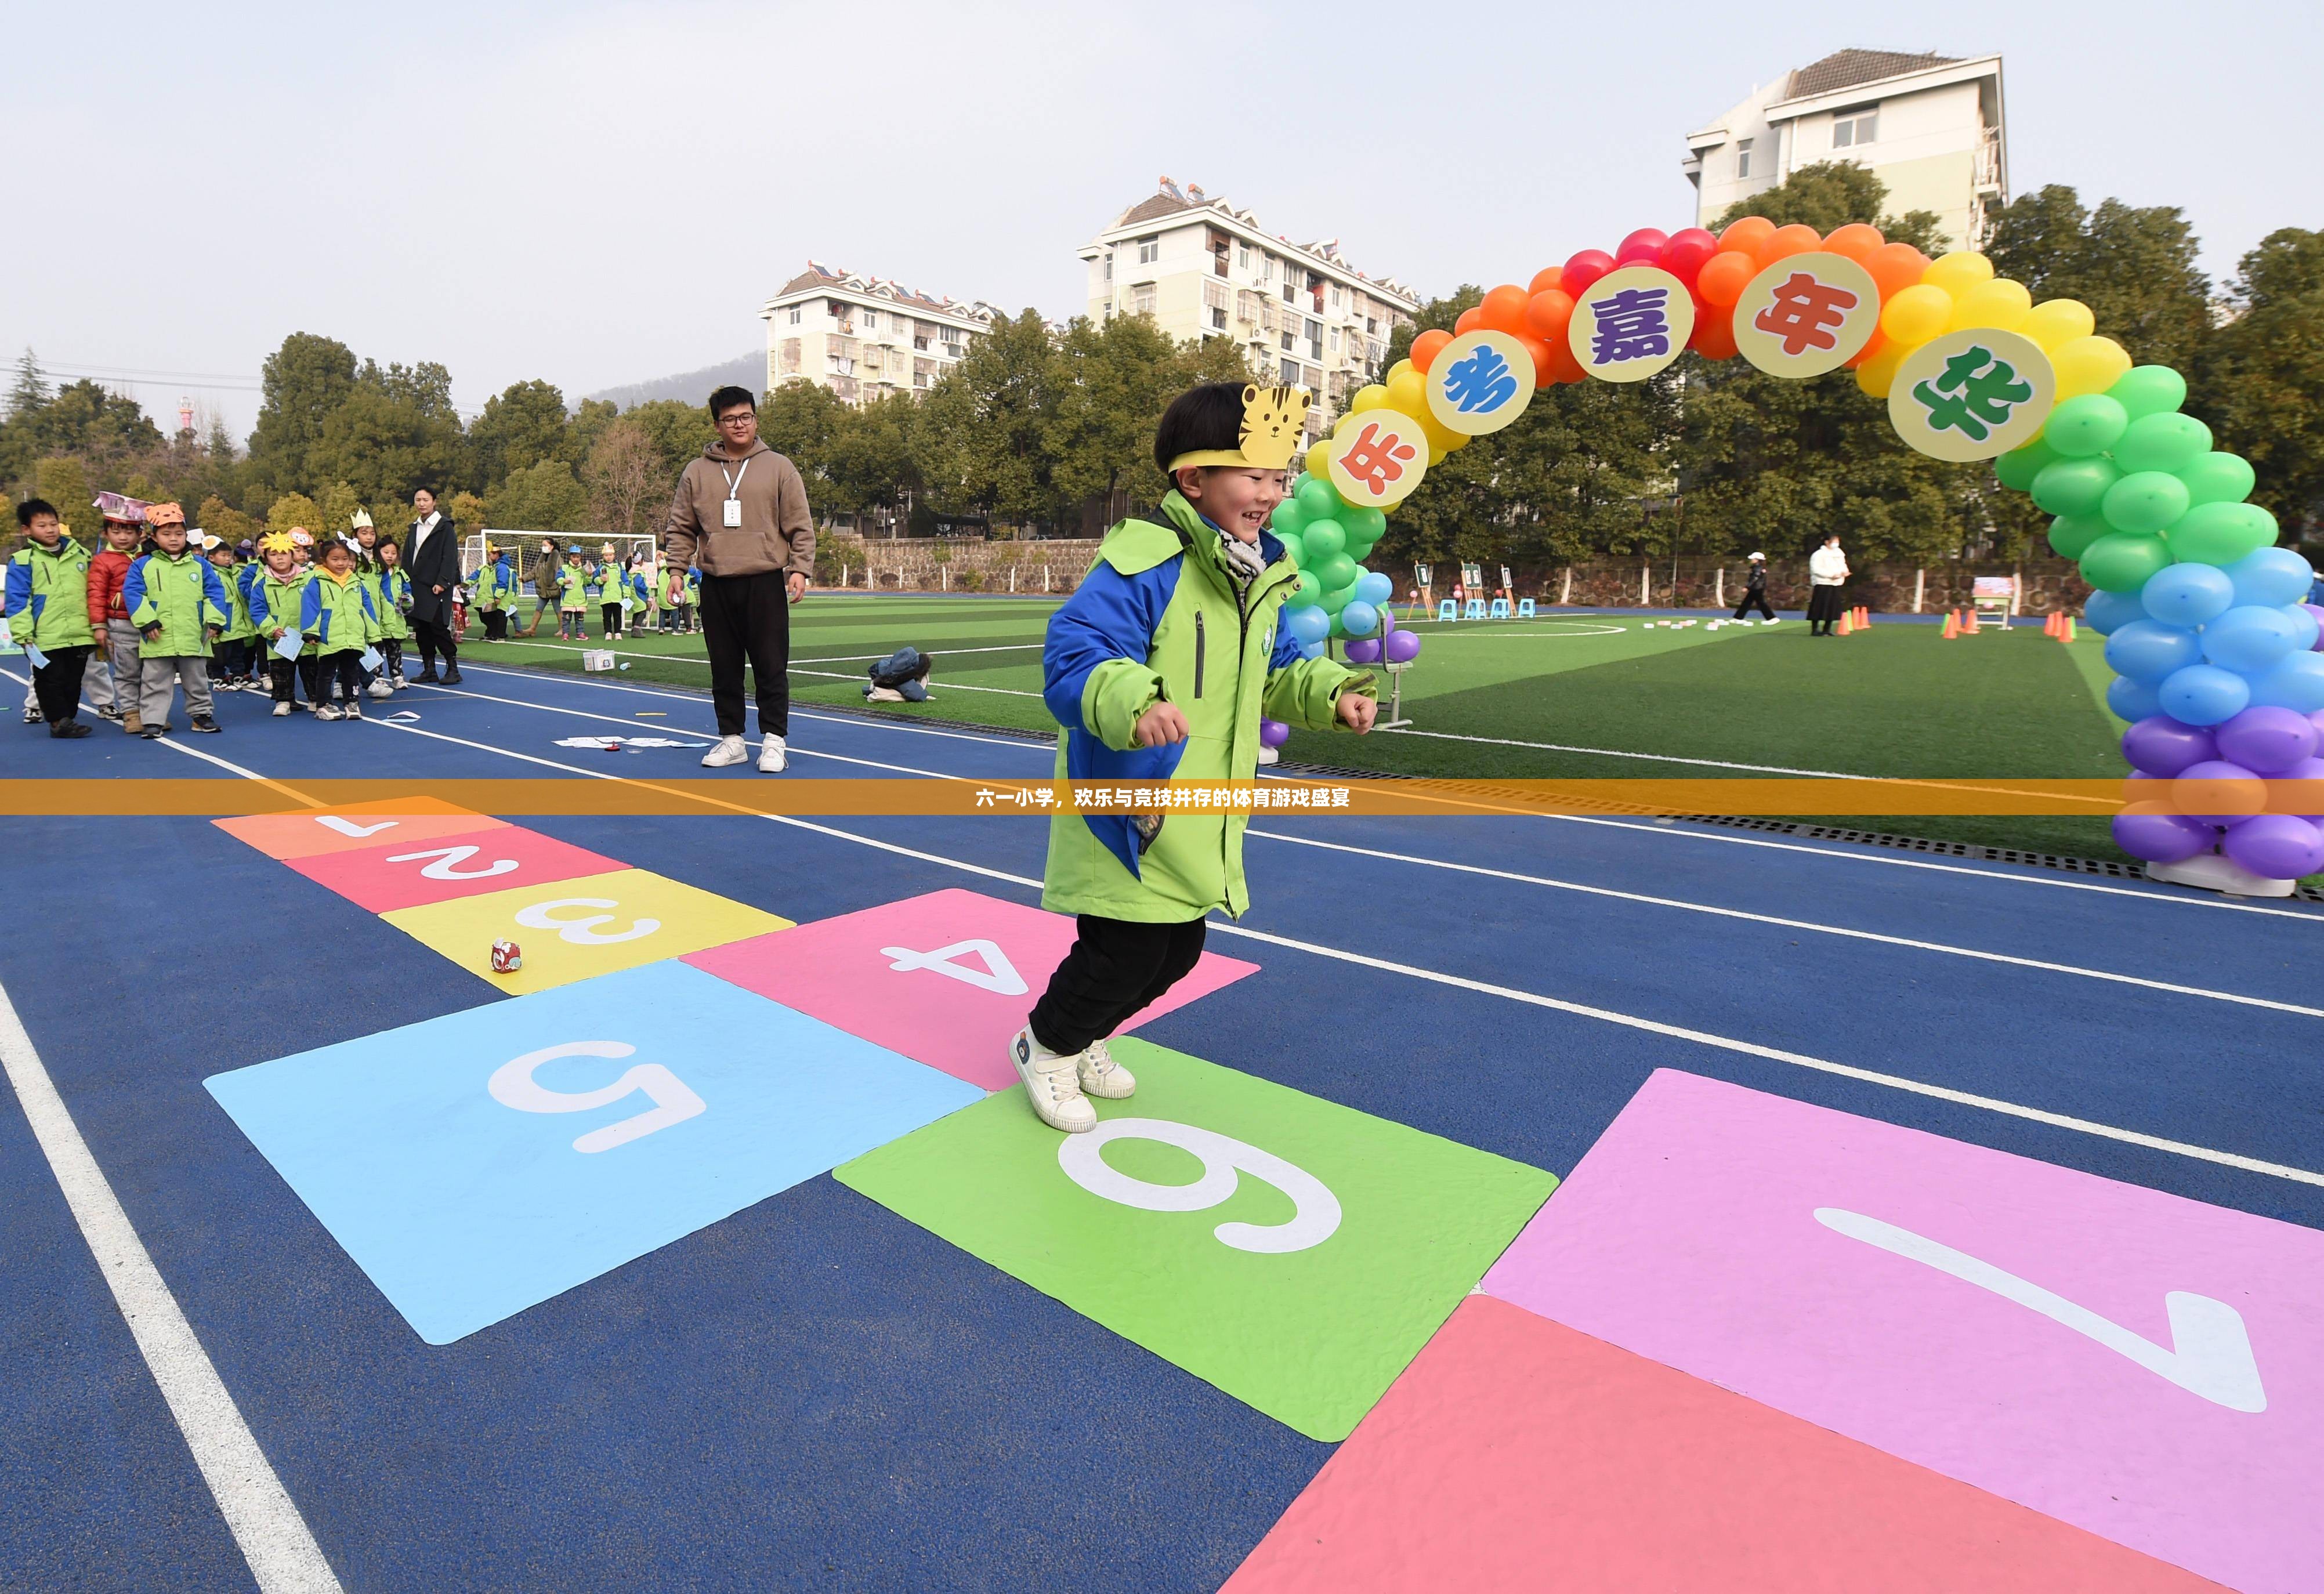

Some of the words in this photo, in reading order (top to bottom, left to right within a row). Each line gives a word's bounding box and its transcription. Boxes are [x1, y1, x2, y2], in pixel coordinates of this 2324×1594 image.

[314, 816, 399, 838] 1
[385, 845, 519, 880] 2
[515, 897, 661, 945] 3
[879, 939, 1029, 995] 4
[488, 1041, 707, 1153] 5
[1058, 1117, 1342, 1254] 6
